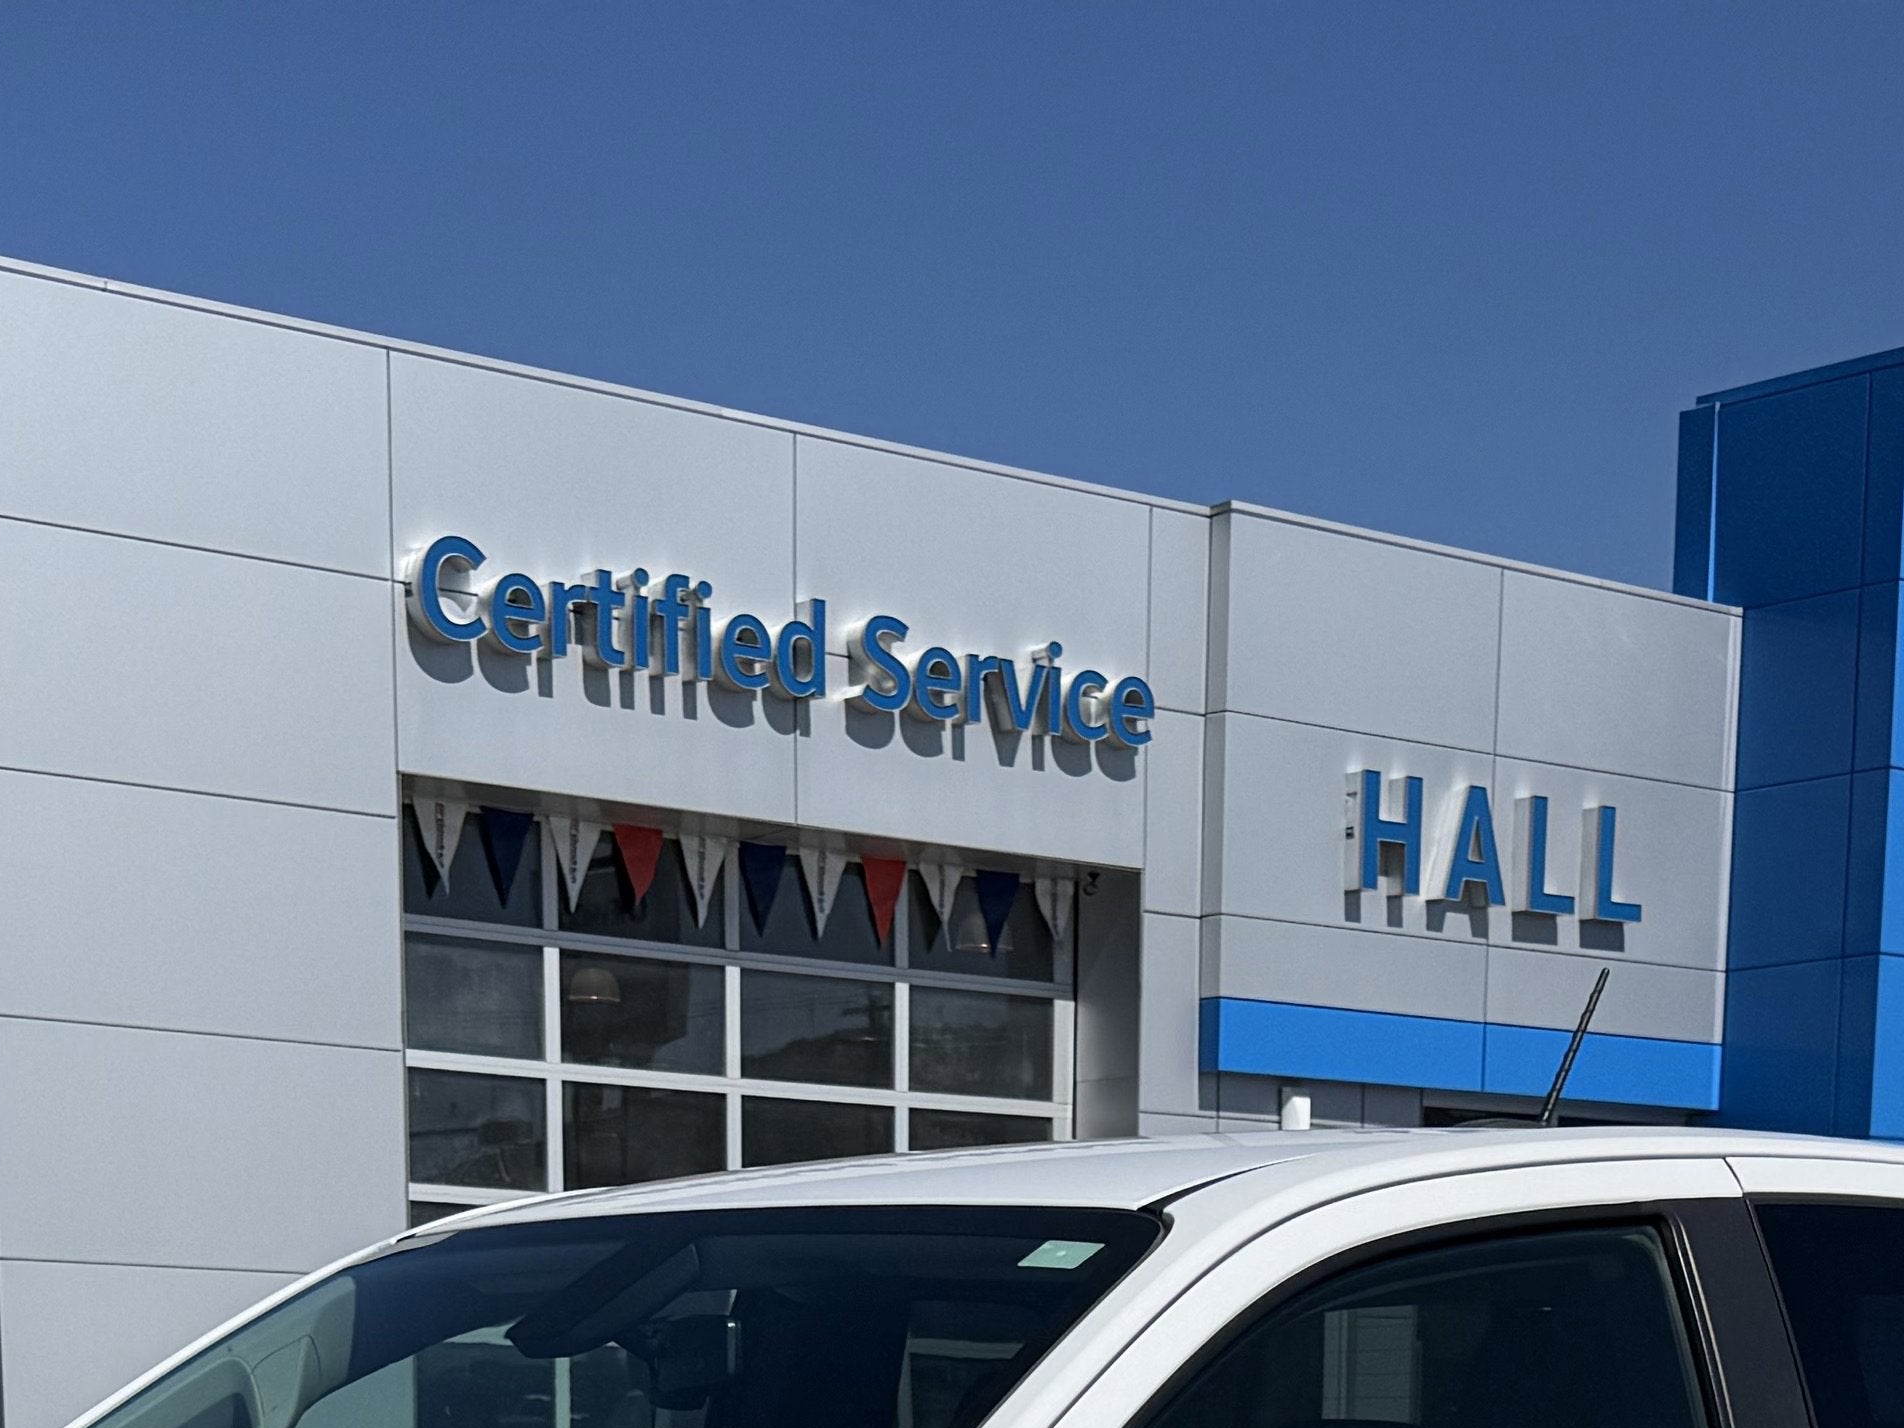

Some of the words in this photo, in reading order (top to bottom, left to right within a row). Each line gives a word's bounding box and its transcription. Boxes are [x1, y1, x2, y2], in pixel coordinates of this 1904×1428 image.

[414, 535, 826, 700] Certified
[861, 614, 1155, 746] Service
[1352, 769, 1642, 922] HALL
